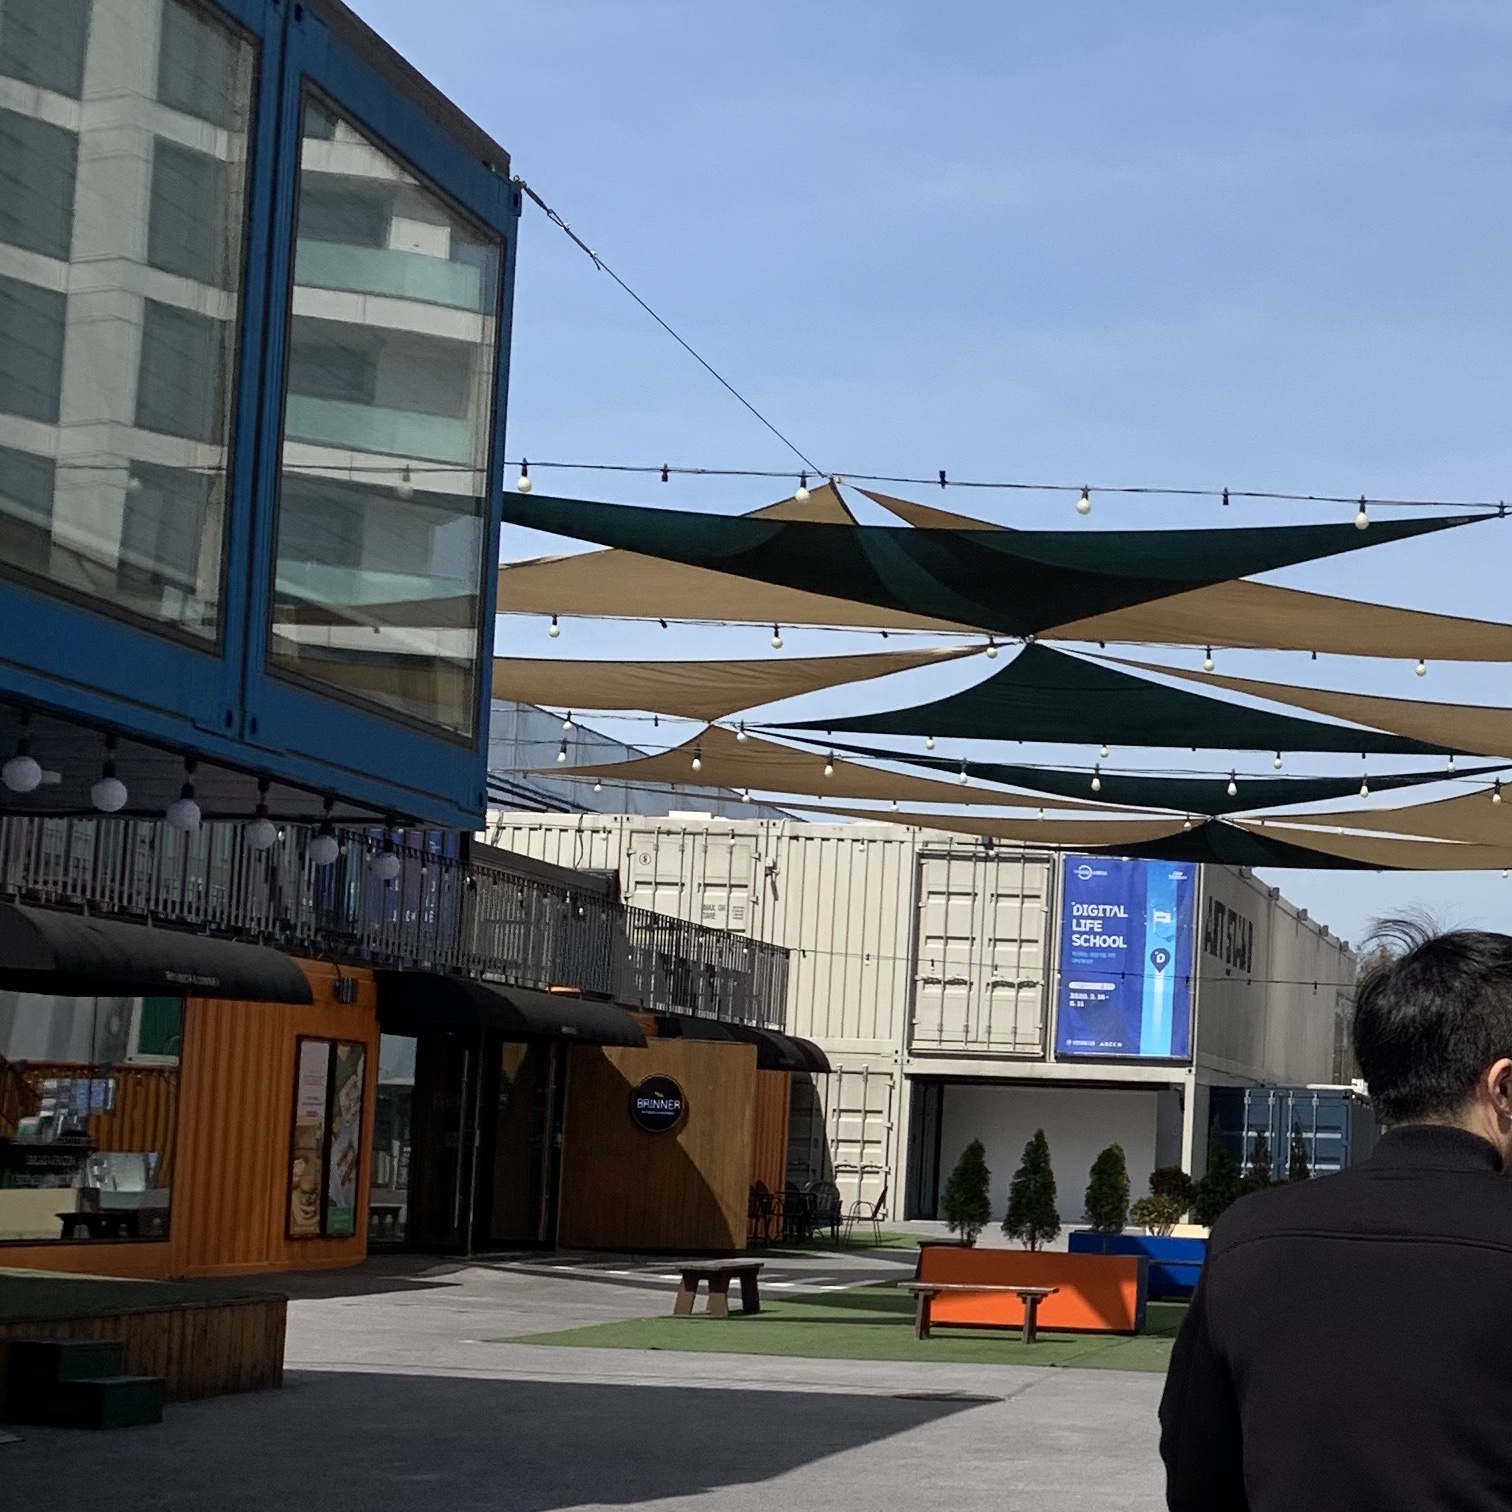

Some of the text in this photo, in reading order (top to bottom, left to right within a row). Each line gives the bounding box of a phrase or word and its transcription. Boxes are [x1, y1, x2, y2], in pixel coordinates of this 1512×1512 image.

[1071, 902, 1128, 918] DIGITAL
[1072, 919, 1103, 932] LIFE
[1071, 934, 1128, 949] SCHOOL
[636, 1097, 681, 1110] BRINNER
